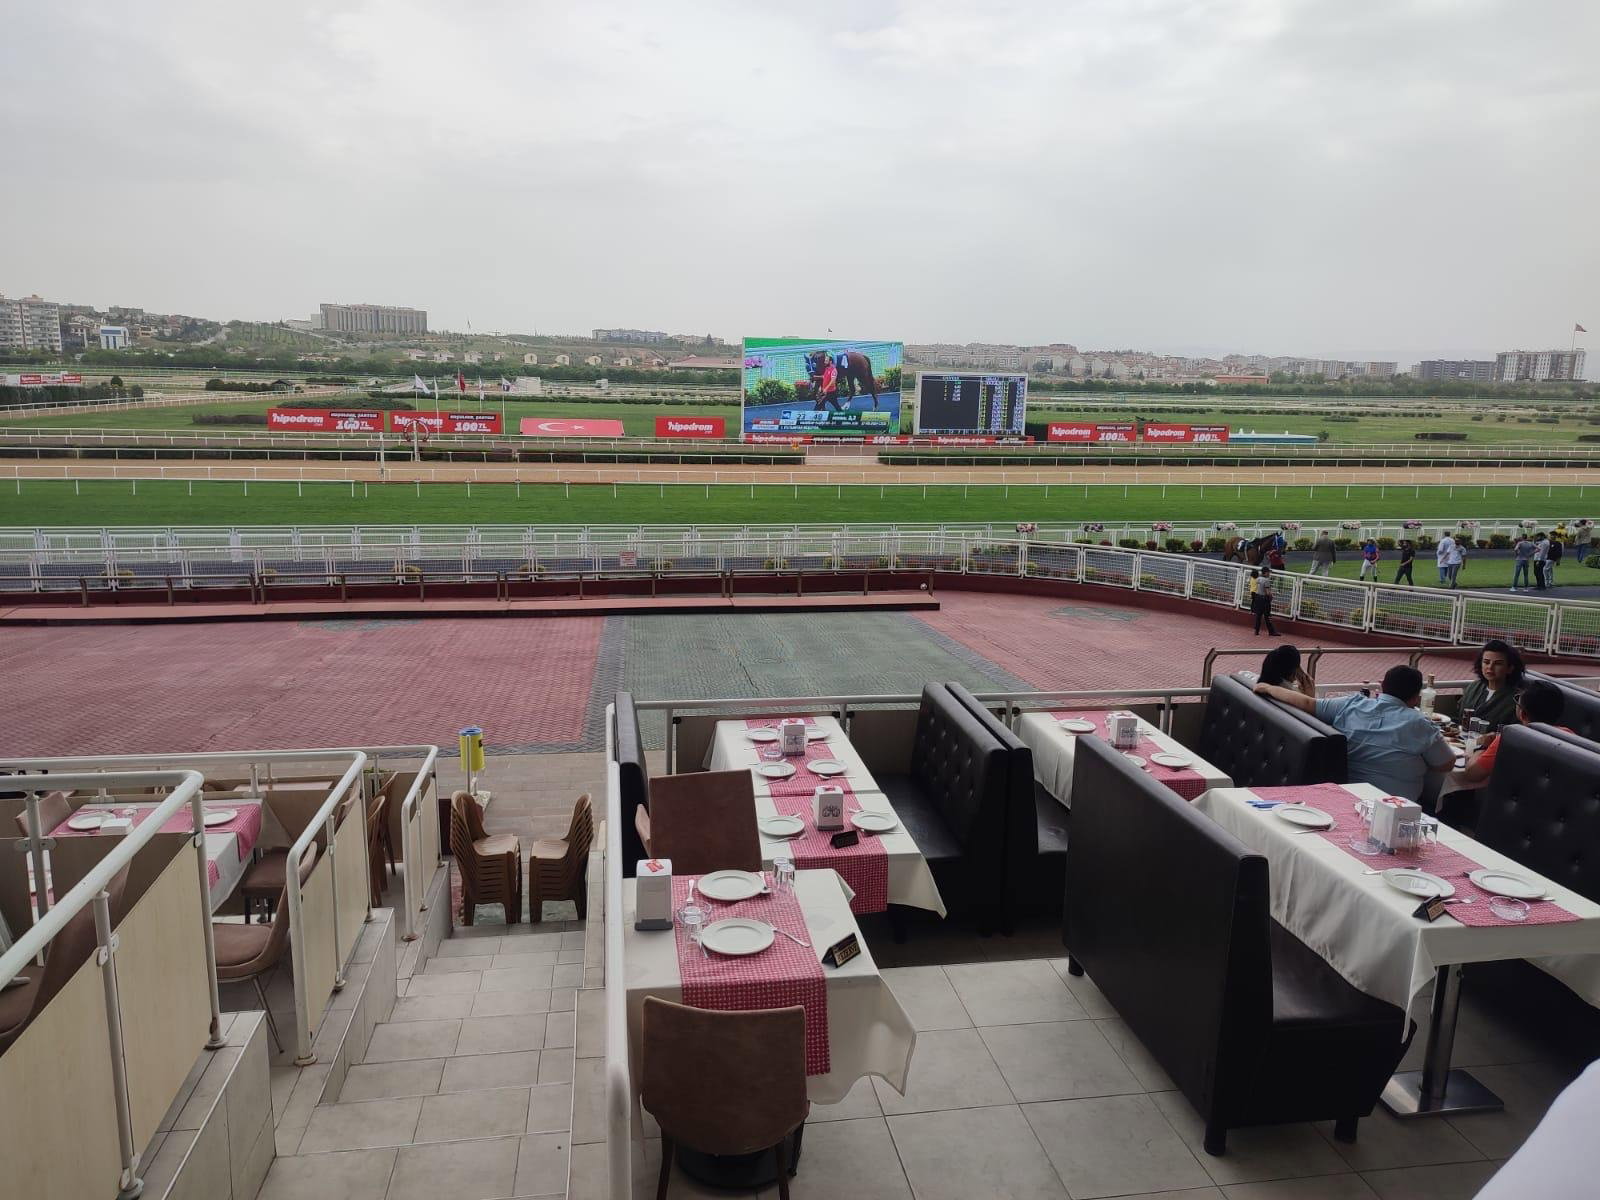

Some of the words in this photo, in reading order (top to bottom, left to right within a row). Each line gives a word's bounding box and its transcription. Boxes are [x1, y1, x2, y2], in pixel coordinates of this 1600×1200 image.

[272, 413, 323, 424] hipodrom
[394, 416, 443, 426] hipdrom
[455, 422, 477, 431] 100
[667, 421, 713, 432] hipodrom
[1052, 426, 1091, 436] hipodrom
[1099, 433, 1117, 441] 100
[1147, 428, 1185, 437] hipodrom
[1193, 433, 1211, 441] 100
